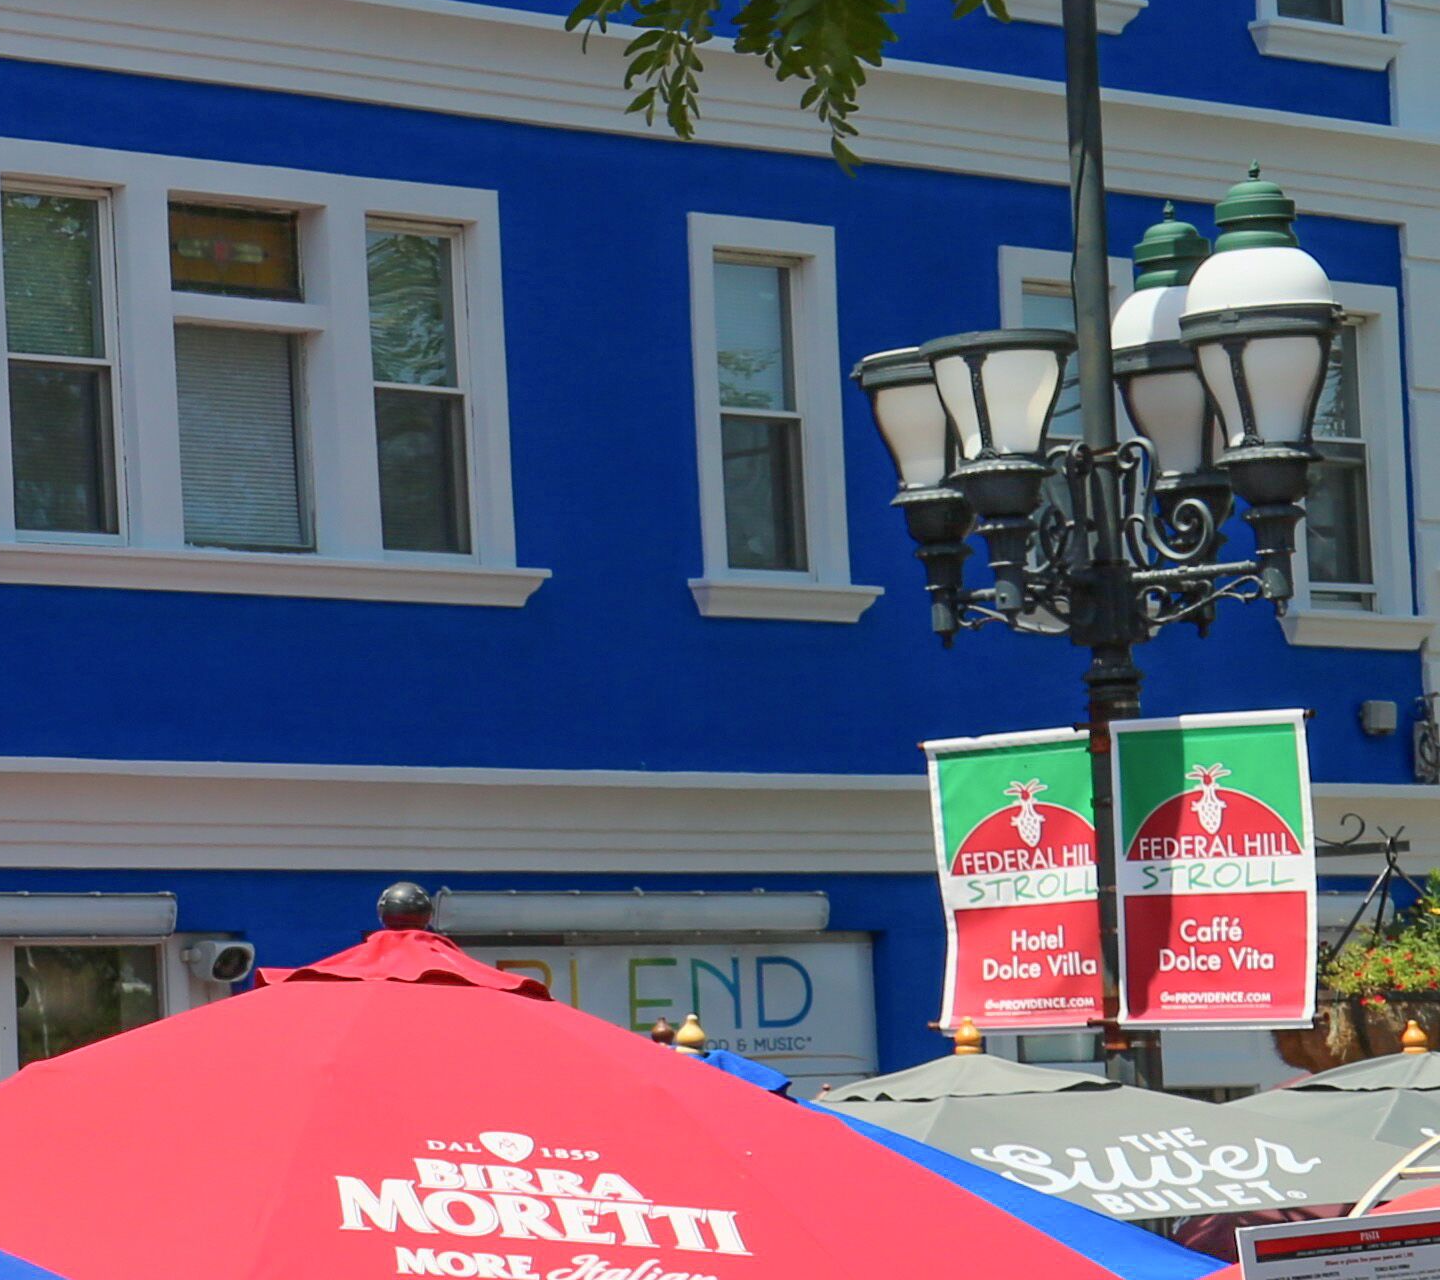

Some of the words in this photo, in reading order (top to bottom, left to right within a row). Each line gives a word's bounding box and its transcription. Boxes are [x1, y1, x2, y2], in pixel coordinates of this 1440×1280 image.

[961, 846, 1058, 875] FEDERAL
[1063, 843, 1095, 868] HIL
[1139, 834, 1238, 860] FEDERAL
[1244, 832, 1292, 857] HILL
[967, 870, 1099, 904] STROLL
[1142, 861, 1295, 890] STROLL
[1011, 925, 1064, 952] Hotel
[1180, 916, 1243, 943] Caffé
[983, 955, 1041, 981] Dolce
[1047, 951, 1097, 976] Villa
[1159, 946, 1221, 972] Dolce
[1229, 947, 1274, 970] Vita
[737, 1037, 747, 1052] &
[426, 1139, 482, 1154] DAL
[540, 1147, 600, 1161] 1859
[1119, 1126, 1208, 1153] THE
[412, 1157, 653, 1203] BIRRA
[970, 1137, 1322, 1195] Silver
[334, 1175, 755, 1257] MORETTI
[394, 1246, 540, 1280] MORE
